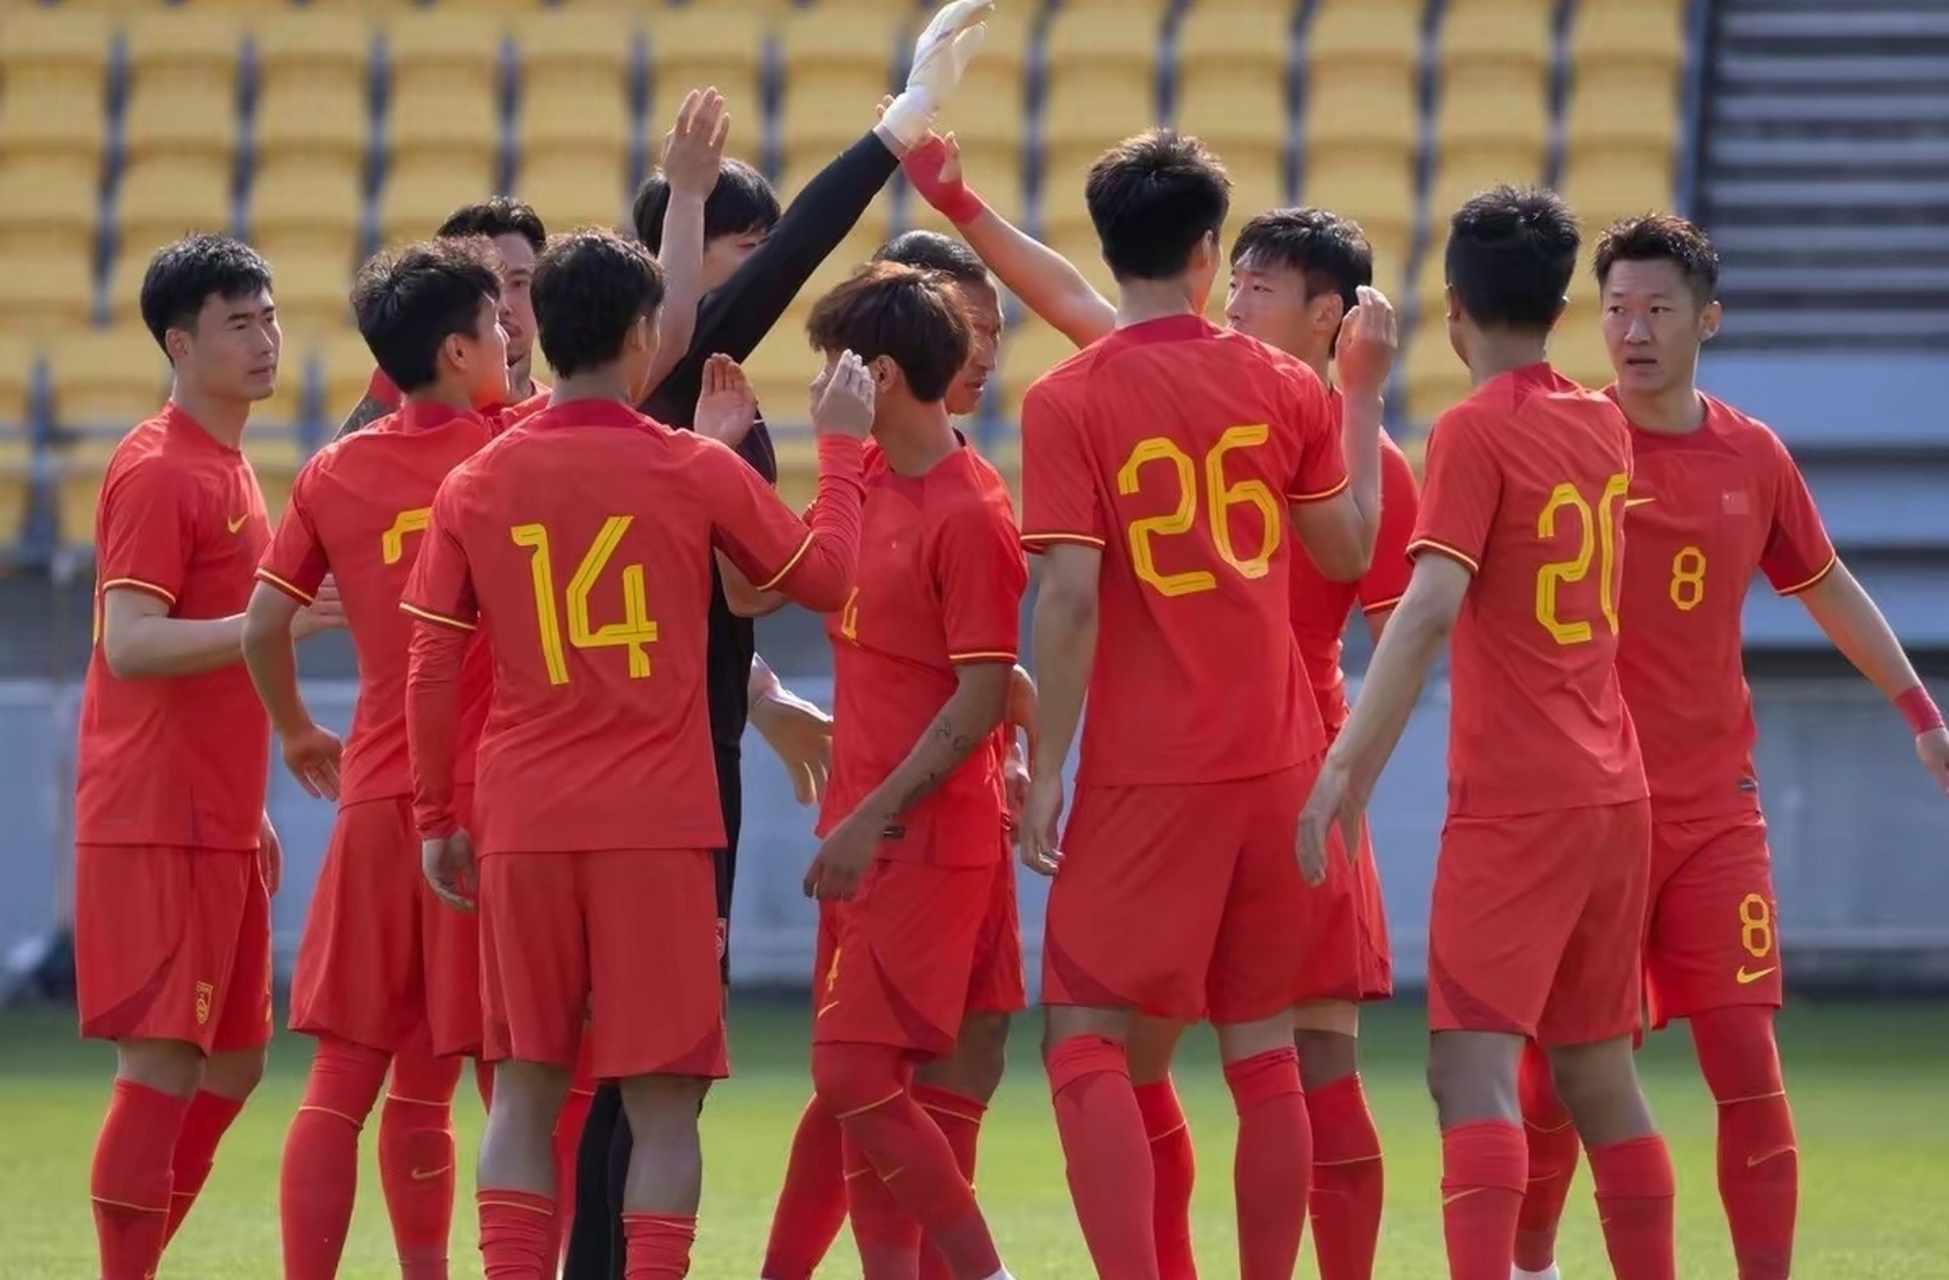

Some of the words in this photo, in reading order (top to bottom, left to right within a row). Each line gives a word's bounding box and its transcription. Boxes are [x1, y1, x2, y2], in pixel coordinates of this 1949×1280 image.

[1117, 423, 1281, 597] 26
[511, 515, 658, 686] 14
[1669, 546, 1706, 611] 8
[1738, 892, 1772, 958] 8
